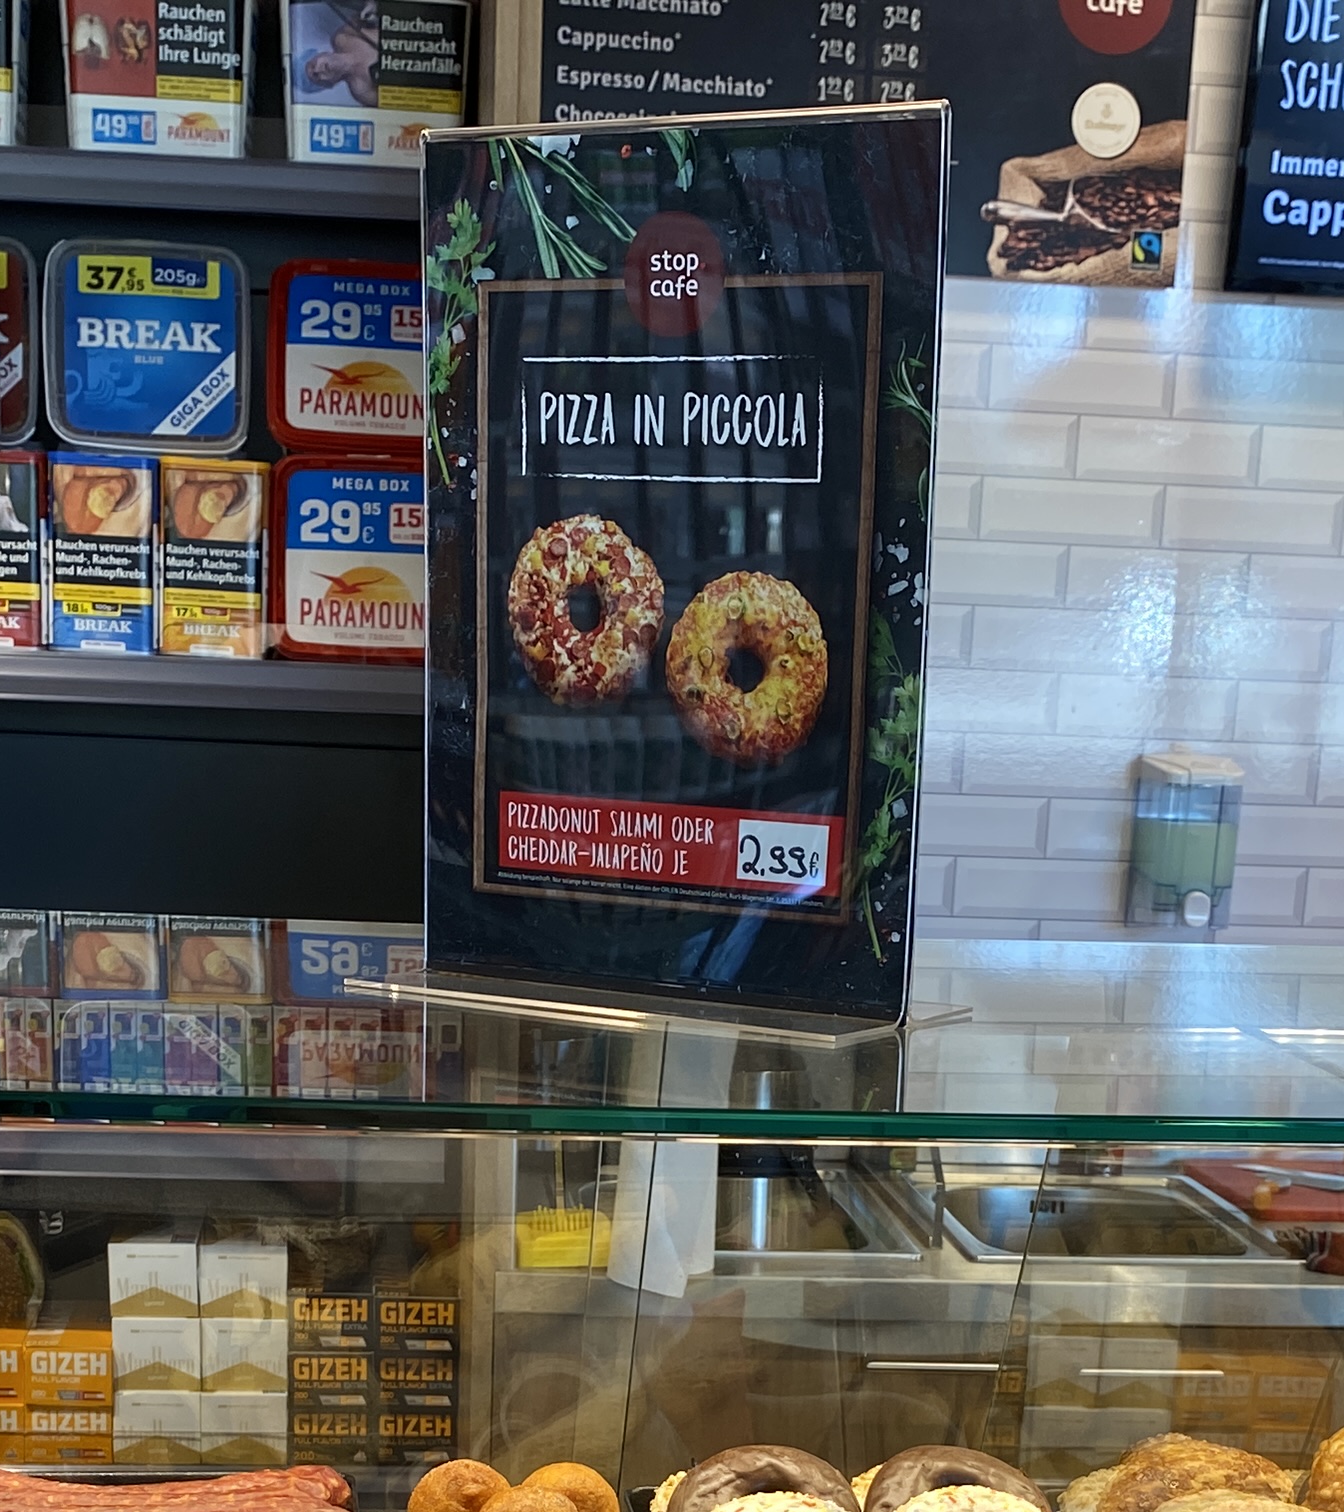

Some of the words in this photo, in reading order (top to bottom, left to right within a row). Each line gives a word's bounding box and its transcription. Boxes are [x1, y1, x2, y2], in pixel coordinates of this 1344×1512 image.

[158, 2, 226, 23] Rauchen
[1284, 0, 1340, 44] DIE
[158, 24, 226, 44] schädigt
[381, 15, 443, 34] Rauchen
[159, 44, 190, 63] Ihre
[194, 47, 241, 70] Lunge
[381, 37, 457, 55] verursacht
[380, 57, 462, 76] Herzanfälle
[556, 65, 644, 89] Espresso
[650, 251, 699, 276] stop
[333, 281, 374, 295] MEGA
[380, 284, 410, 296] BOX
[650, 277, 698, 300] cafe
[77, 317, 222, 353] BREAK
[170, 396, 203, 428] GIGA
[201, 367, 230, 397] BOX
[539, 392, 615, 446] PIZZA
[634, 393, 665, 446] IN
[683, 392, 807, 448] PICCOLA
[332, 477, 374, 491] MEGA
[379, 479, 410, 492] BOX
[9, 552, 30, 563] und
[507, 801, 601, 834] PIZZADONUT
[610, 810, 663, 838] SALAMI
[671, 818, 715, 845] ODER
[507, 836, 663, 875] CHEDDAR-JALAPEÑO
[671, 849, 690, 876] JE
[293, 1298, 368, 1321] GIZEH
[380, 1302, 454, 1325] GIZEH
[31, 1352, 106, 1376] GIZEH
